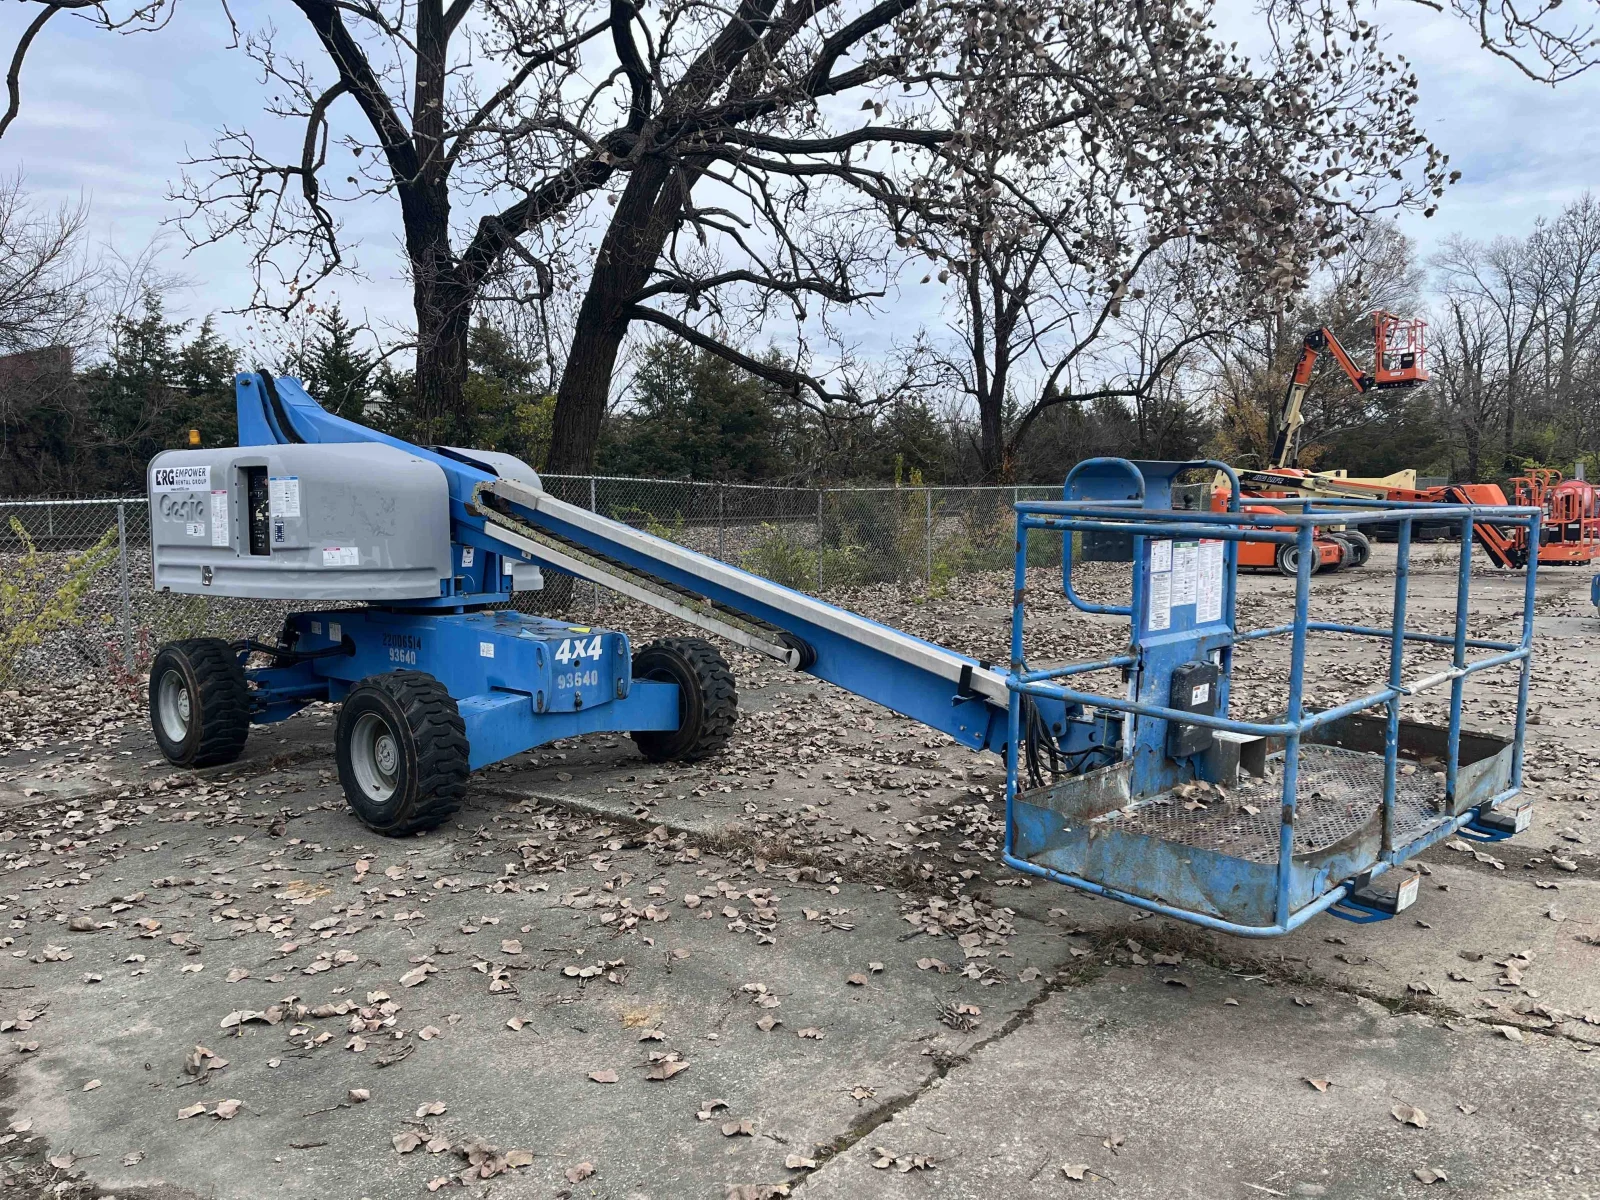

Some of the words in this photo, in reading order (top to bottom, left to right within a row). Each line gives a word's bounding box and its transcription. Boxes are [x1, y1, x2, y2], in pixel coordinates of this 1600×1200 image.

[156, 469, 175, 486] ERG
[175, 468, 206, 477] EMPOWER
[160, 493, 205, 522] Genie
[382, 632, 422, 651] 22006514
[389, 647, 416, 665] 93640
[557, 670, 598, 689] 93640
